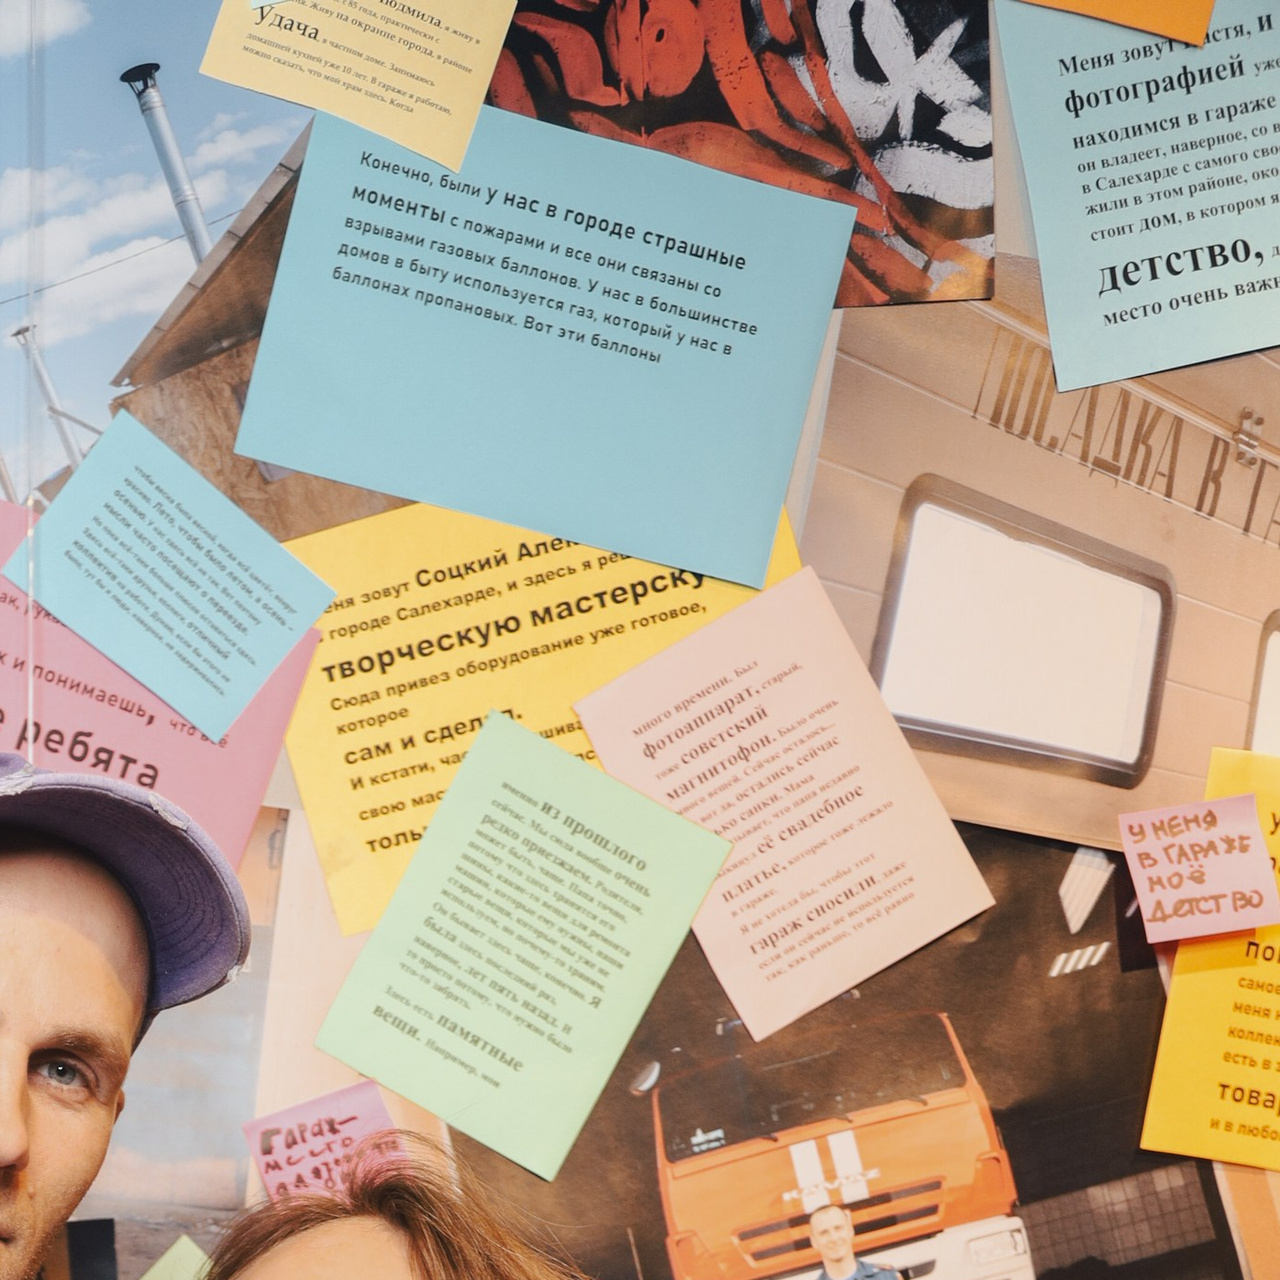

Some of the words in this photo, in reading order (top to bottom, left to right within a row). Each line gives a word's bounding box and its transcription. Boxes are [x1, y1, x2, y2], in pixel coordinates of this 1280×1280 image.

[1058, 52, 1114, 73] Меня
[1064, 53, 1244, 119] фотографией
[1072, 115, 1180, 149] находимся
[1204, 96, 1276, 123] гараже
[1100, 147, 1167, 169] владеет,
[1170, 130, 1247, 154] наверное,
[1085, 197, 1129, 215] жили
[1187, 174, 1248, 198] районе,
[1094, 166, 1178, 191] Салехарде
[359, 150, 433, 187] Конечно,
[438, 173, 481, 197] были
[502, 191, 540, 213] нас
[563, 208, 635, 240] городе
[642, 230, 746, 270] страшные
[1199, 195, 1266, 219] котором
[351, 185, 446, 223] моменты
[462, 219, 545, 250] пожарами
[564, 246, 592, 263] все
[596, 255, 627, 273] они
[630, 265, 699, 292] связаны
[336, 242, 390, 265] домов
[408, 258, 449, 283] быту
[452, 273, 564, 311] используется
[568, 303, 597, 322] газ,
[602, 313, 672, 340] который
[344, 216, 425, 247] взрывами
[429, 239, 496, 266] газовых
[500, 256, 581, 290] баллонов.
[601, 286, 631, 303] нас
[649, 295, 757, 336] большинстве
[1098, 238, 1264, 297] детство,
[331, 265, 410, 297] баллонах
[414, 289, 517, 326] пропановых.
[590, 333, 661, 363] баллоны
[1103, 301, 1162, 324] место
[1168, 287, 1228, 310] очень
[360, 581, 410, 604] зовут
[415, 548, 508, 587] Соцкий
[395, 586, 502, 621] Салехарде,
[321, 615, 521, 682] творческую
[385, 670, 451, 697] привез
[455, 634, 584, 677] оборудование
[630, 602, 706, 630] готовое,
[336, 707, 409, 735] которое
[642, 687, 760, 760] фотоаппарат,
[680, 707, 768, 764] советский
[14, 717, 159, 790] ребята
[344, 741, 392, 765] сам
[778, 785, 863, 841] свадебное
[749, 920, 803, 954] гараж
[436, 1014, 523, 1072] памятные
